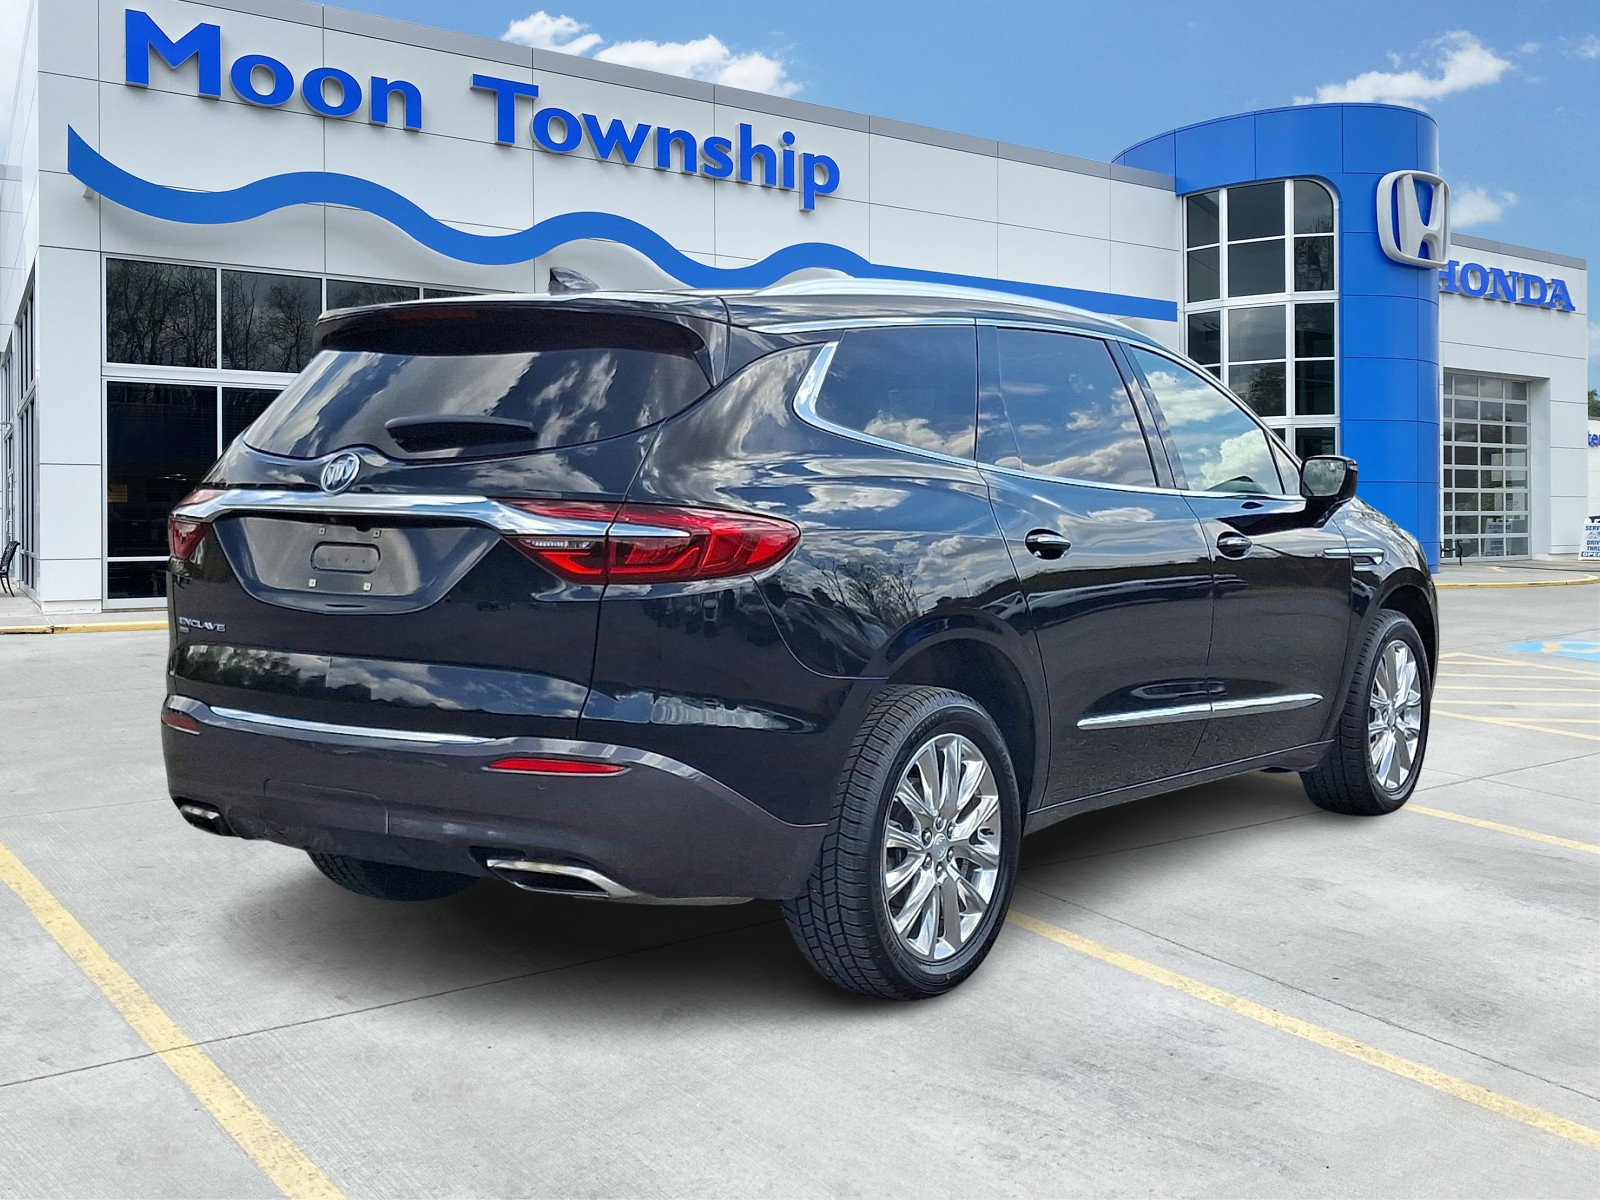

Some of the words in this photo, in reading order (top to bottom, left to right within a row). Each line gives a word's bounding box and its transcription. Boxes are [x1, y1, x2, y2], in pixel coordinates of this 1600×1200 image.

[125, 8, 422, 131] Moon
[469, 73, 840, 212] Township
[1439, 260, 1576, 312] HONDA
[178, 616, 226, 632] ENCLAVE
